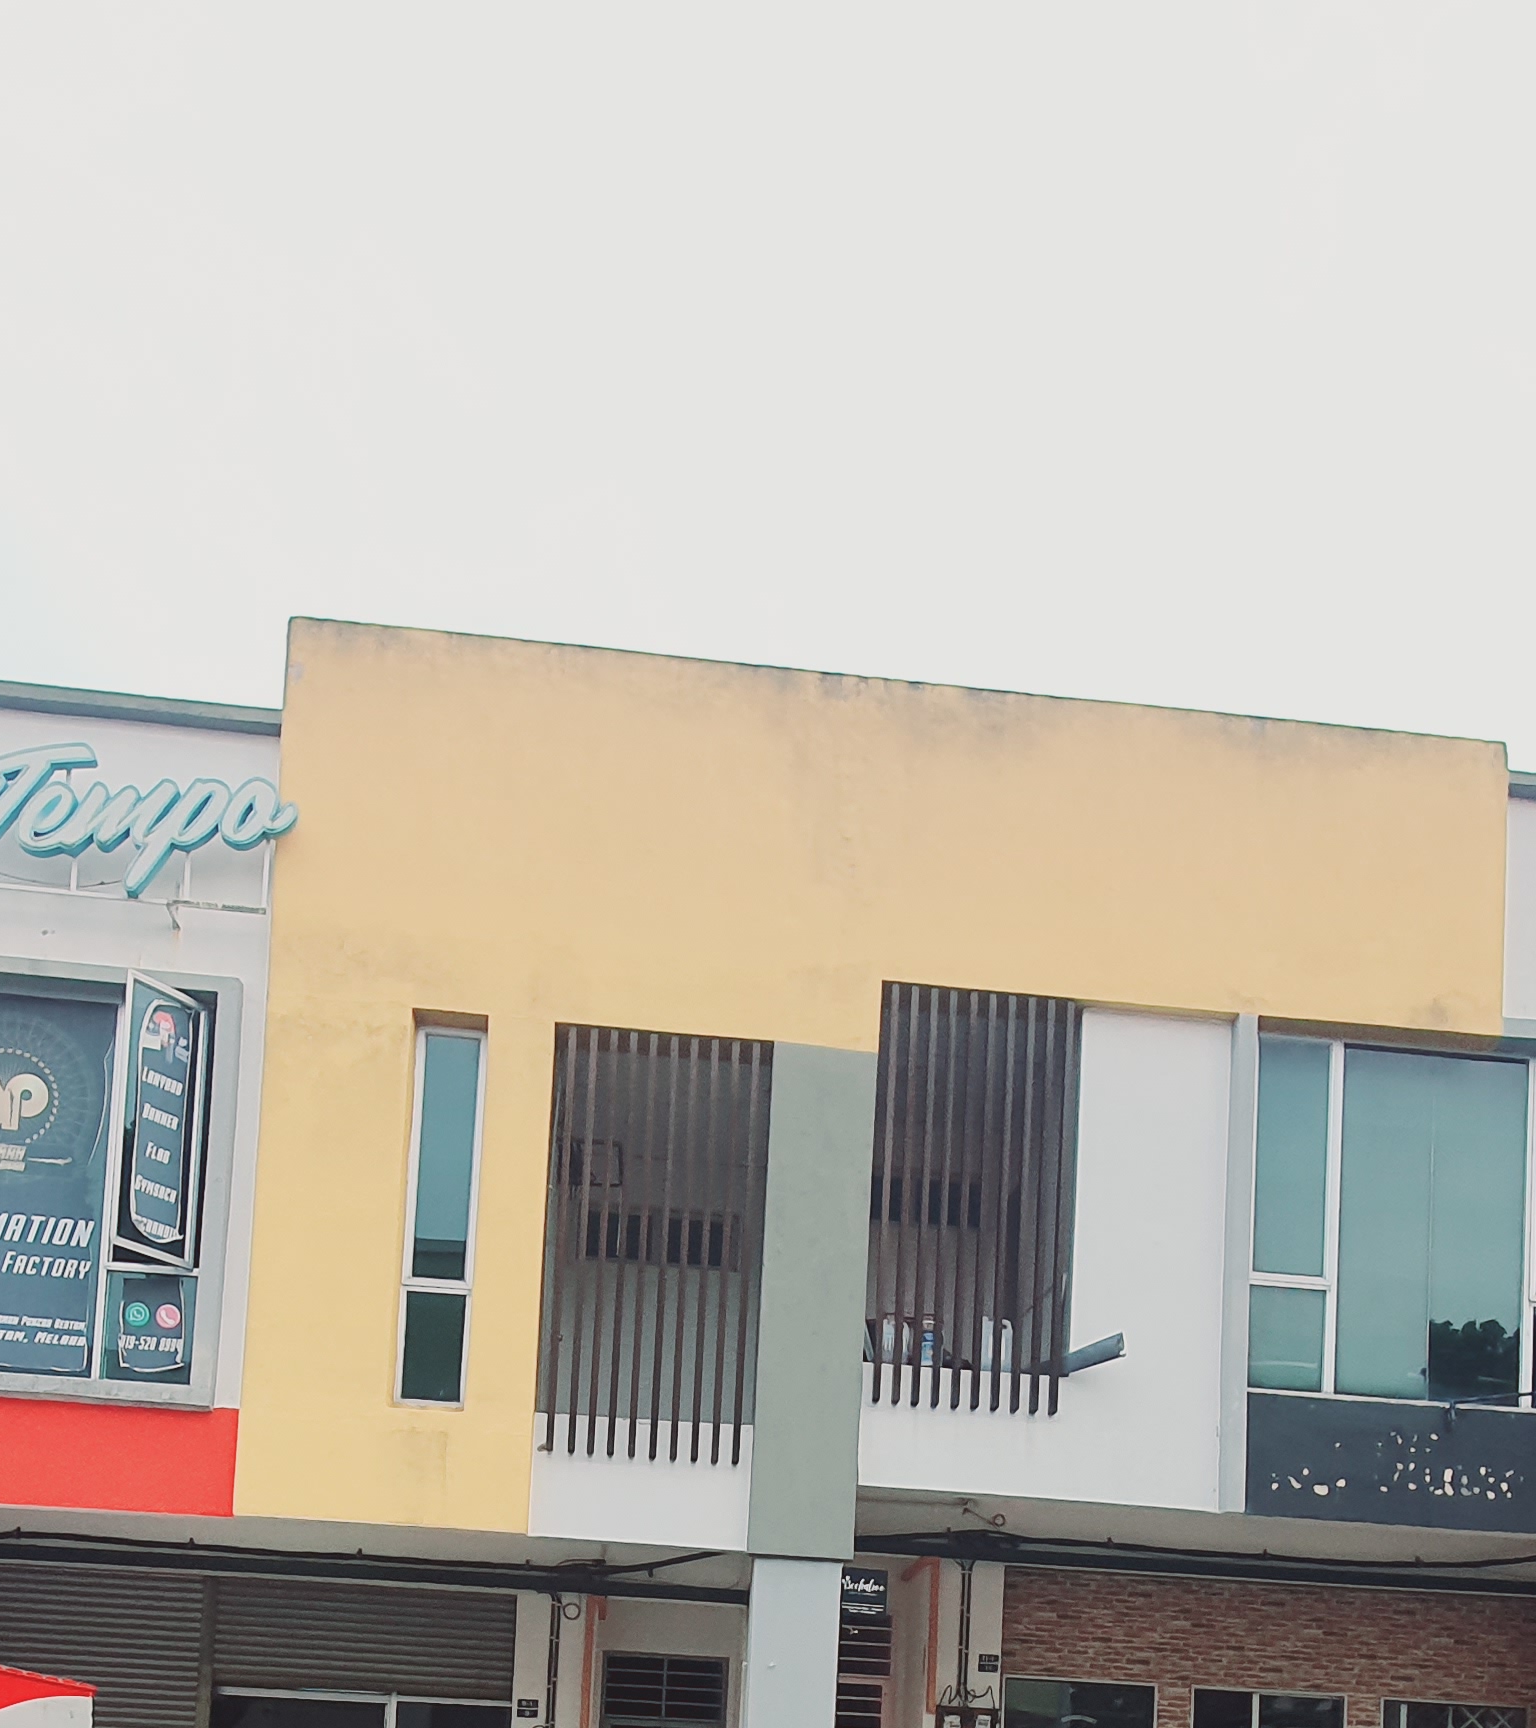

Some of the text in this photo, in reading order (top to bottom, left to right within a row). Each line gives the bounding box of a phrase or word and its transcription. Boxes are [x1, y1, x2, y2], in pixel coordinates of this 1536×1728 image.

[142, 1066, 184, 1096] LANYARD
[142, 1102, 179, 1131] BANNER
[1, 1250, 92, 1280] FACTORY
